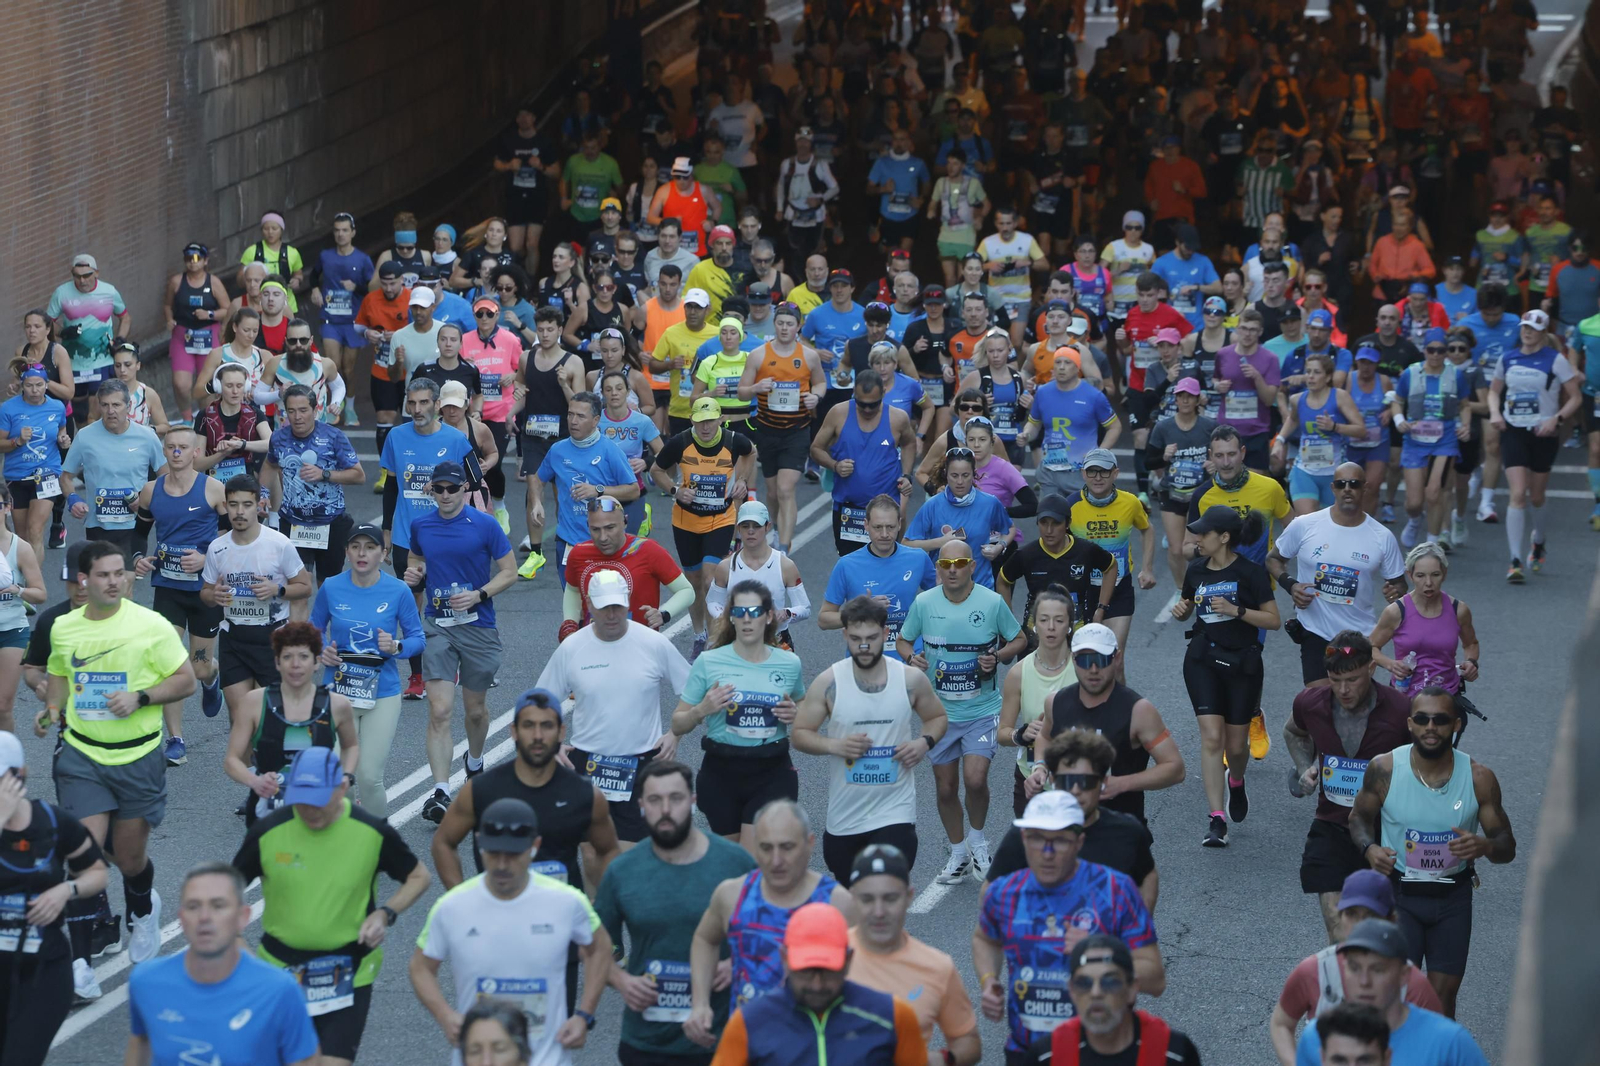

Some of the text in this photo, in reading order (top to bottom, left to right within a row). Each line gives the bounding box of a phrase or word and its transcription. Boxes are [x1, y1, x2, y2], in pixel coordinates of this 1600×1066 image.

[1086, 520, 1119, 532] CEJ
[297, 531, 321, 540] MARIO
[1209, 584, 1232, 592] ZURICH
[1321, 583, 1350, 595] WARDY
[230, 607, 264, 616] MANOLO
[949, 661, 975, 670] ZURICH
[349, 665, 376, 676] ZURICH
[941, 681, 976, 691] ANDRÉS
[335, 684, 372, 699] VANESSA
[746, 694, 775, 703] ZURICH
[75, 701, 98, 709] JULES
[739, 716, 766, 727] SARA
[604, 757, 632, 766] ZURICH
[601, 768, 620, 777] 13049
[852, 772, 891, 784] GEORGE
[1341, 774, 1358, 783] 6207
[591, 776, 627, 791] MARTIN
[1423, 833, 1454, 842] ZURICH
[1424, 849, 1441, 857] 8594
[1421, 858, 1445, 869] MAX
[308, 959, 345, 969] ZURICH
[499, 982, 541, 991] ZURICH
[306, 984, 338, 1001] DIRK
[1024, 1000, 1073, 1016] CHULES
